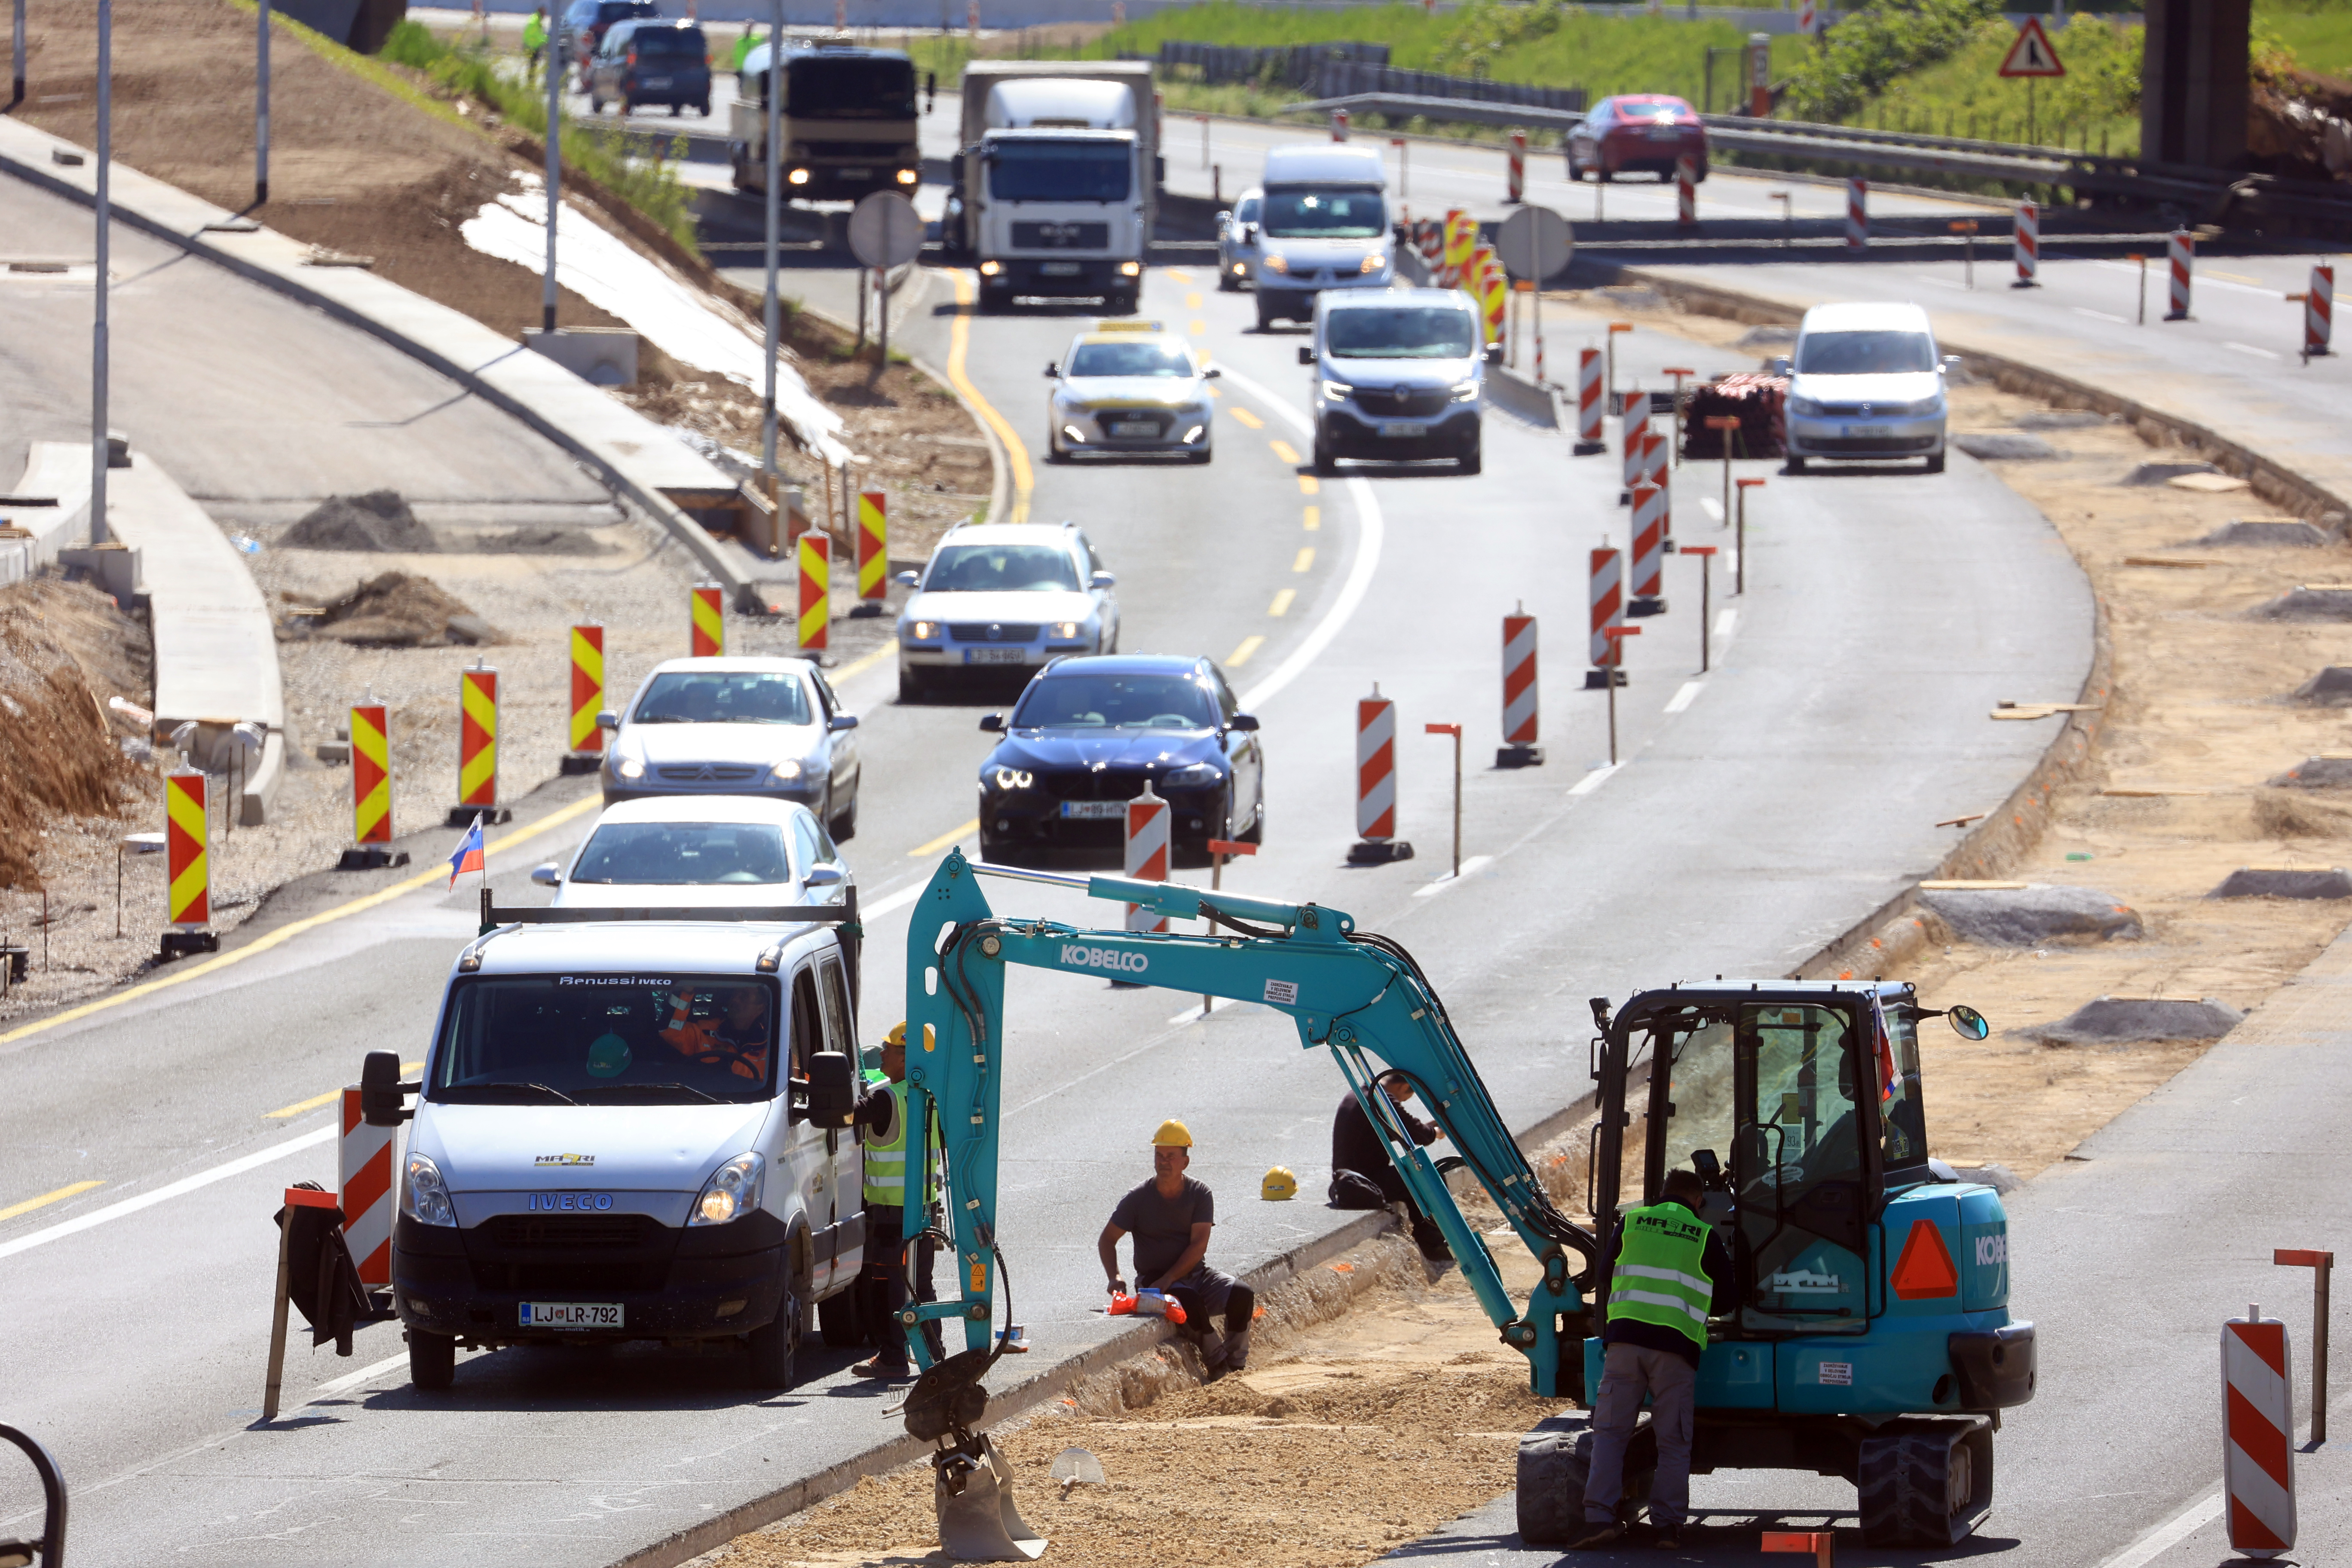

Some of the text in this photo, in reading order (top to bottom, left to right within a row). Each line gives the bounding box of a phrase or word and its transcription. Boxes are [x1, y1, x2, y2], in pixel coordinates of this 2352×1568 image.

[1060, 944, 1148, 973] KOBELCO
[559, 976, 635, 985] Benussi
[529, 1194, 613, 1210] IVECO
[535, 1307, 618, 1323] LJ LR-792
